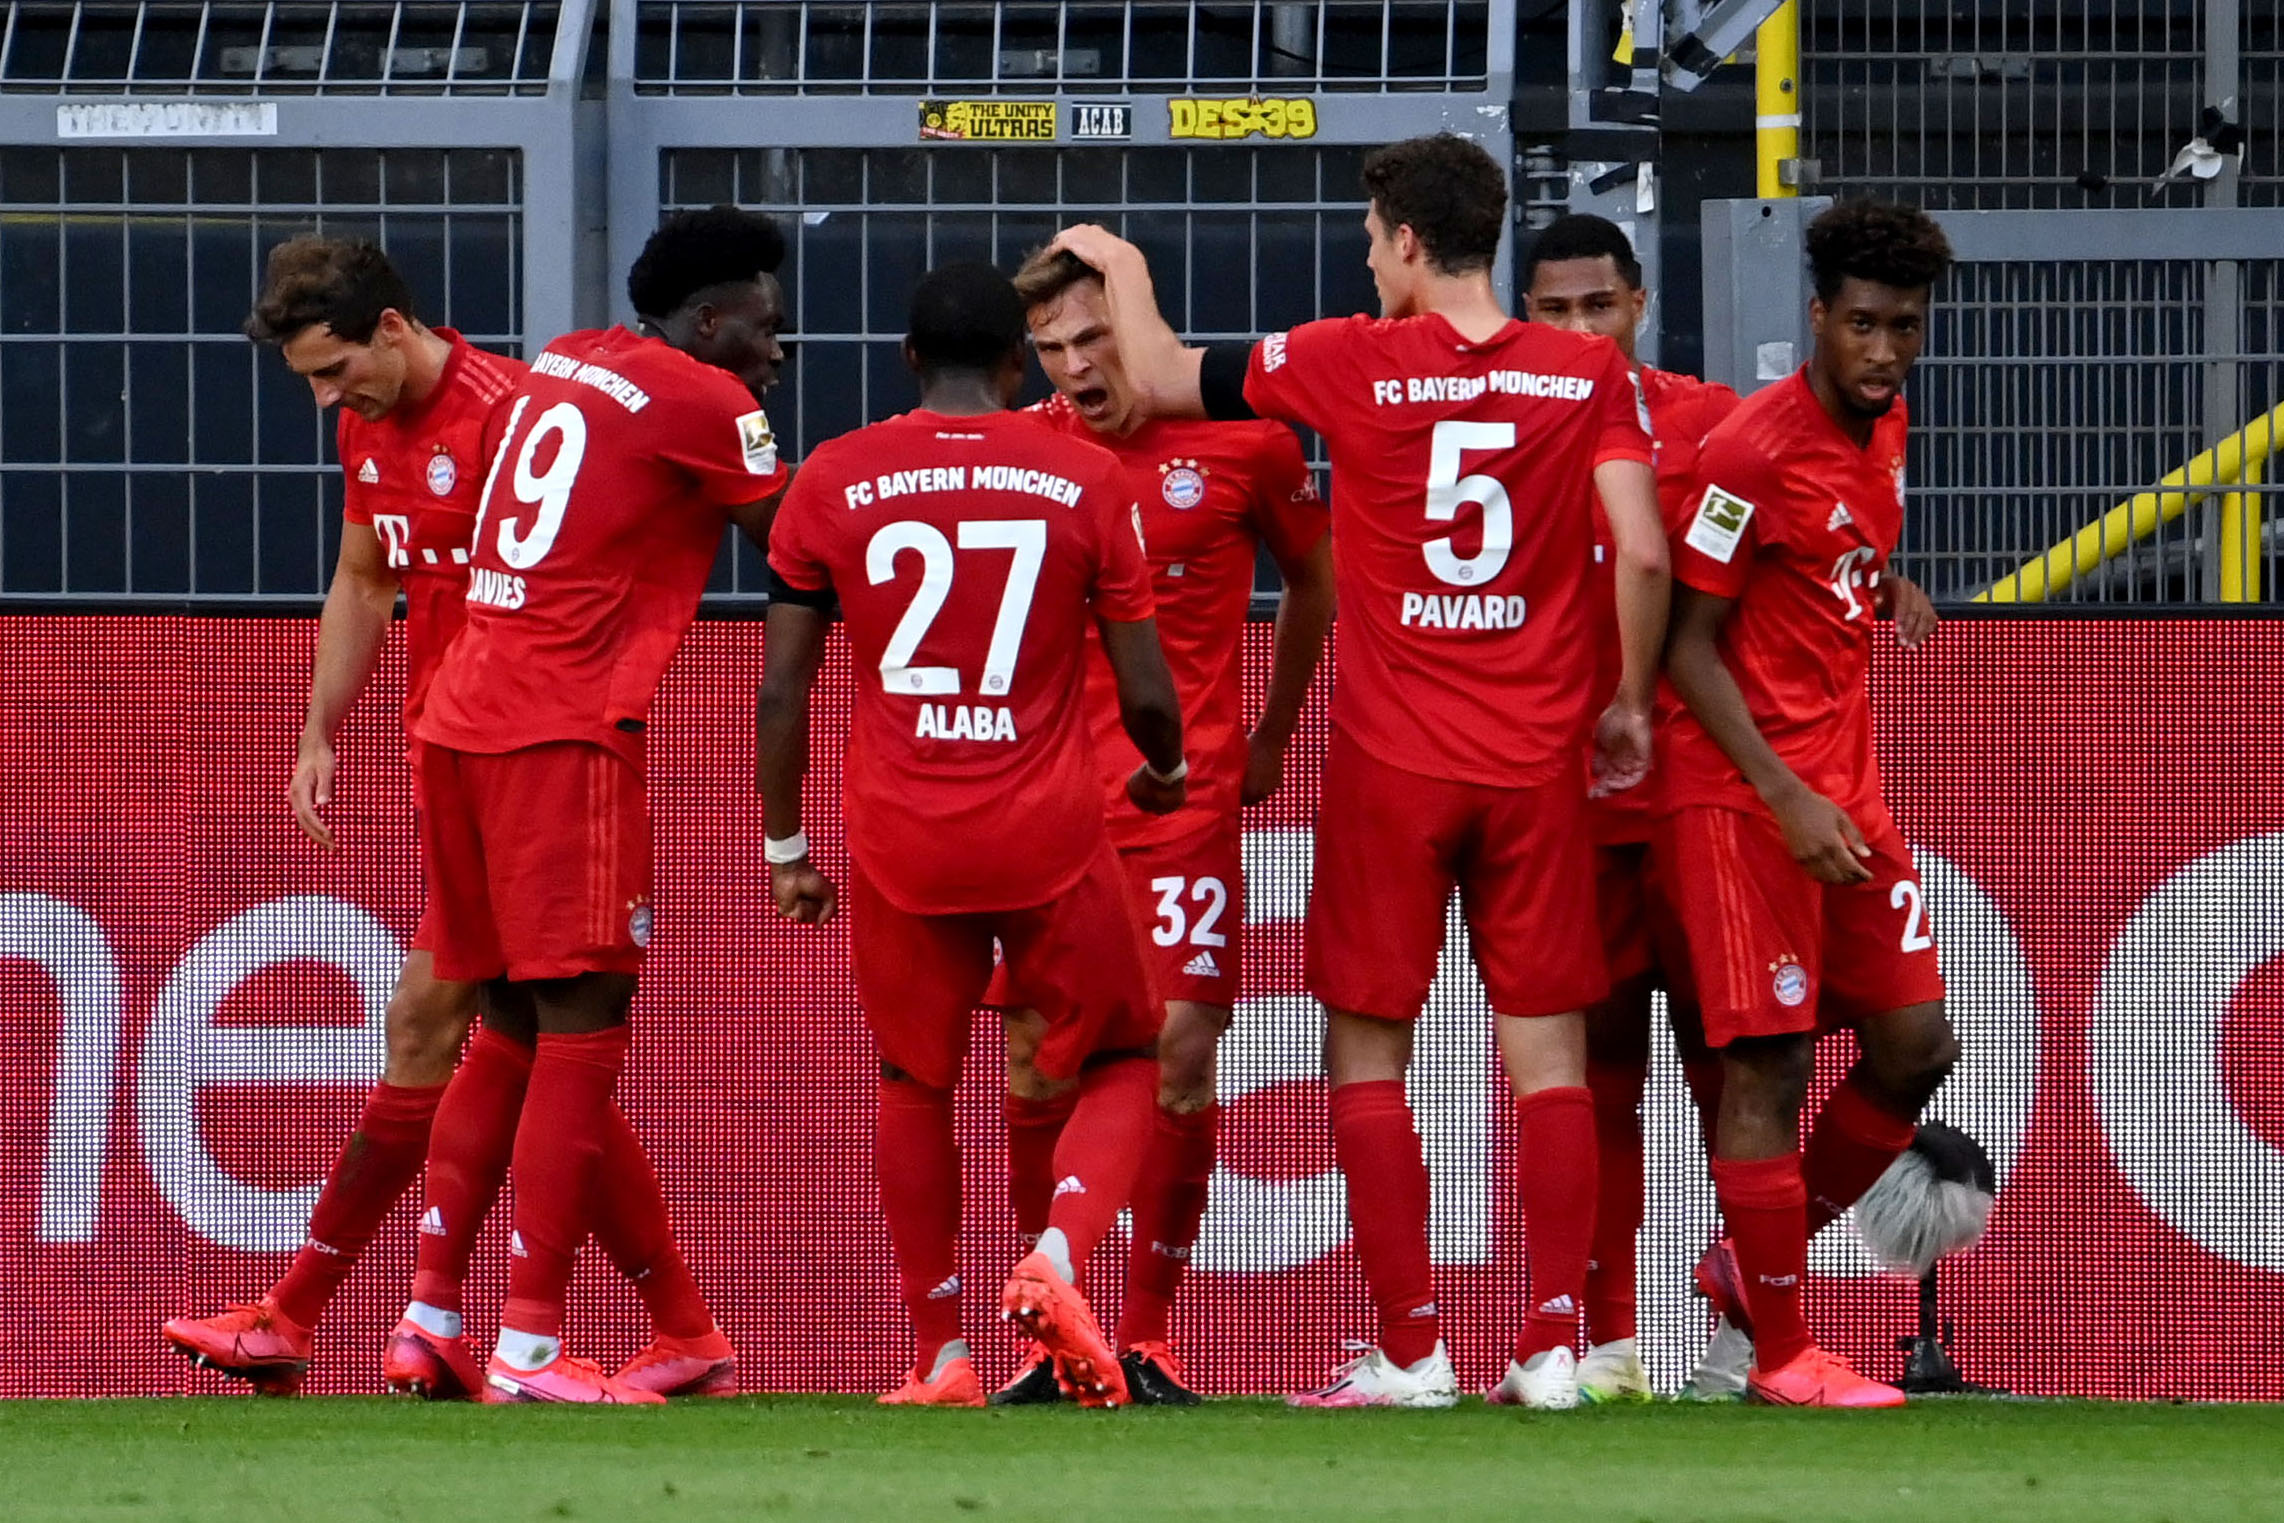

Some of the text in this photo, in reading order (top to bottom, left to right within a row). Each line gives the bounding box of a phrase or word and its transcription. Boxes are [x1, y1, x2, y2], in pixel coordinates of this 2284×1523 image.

[969, 104, 1053, 118] THE UNITY
[969, 119, 1053, 137] ULTRAS
[1078, 107, 1124, 136] ACAB
[1373, 379, 1403, 406] FC
[1407, 375, 1487, 403] BAYERN
[844, 480, 874, 510] FC
[877, 466, 965, 500] BAYERN
[1422, 420, 1516, 587] 5
[865, 519, 1047, 696] 27
[1400, 592, 1526, 630] PAVARD
[915, 703, 1017, 742] ALABA
[1151, 876, 1227, 948] 32
[1890, 879, 1932, 953] 2
